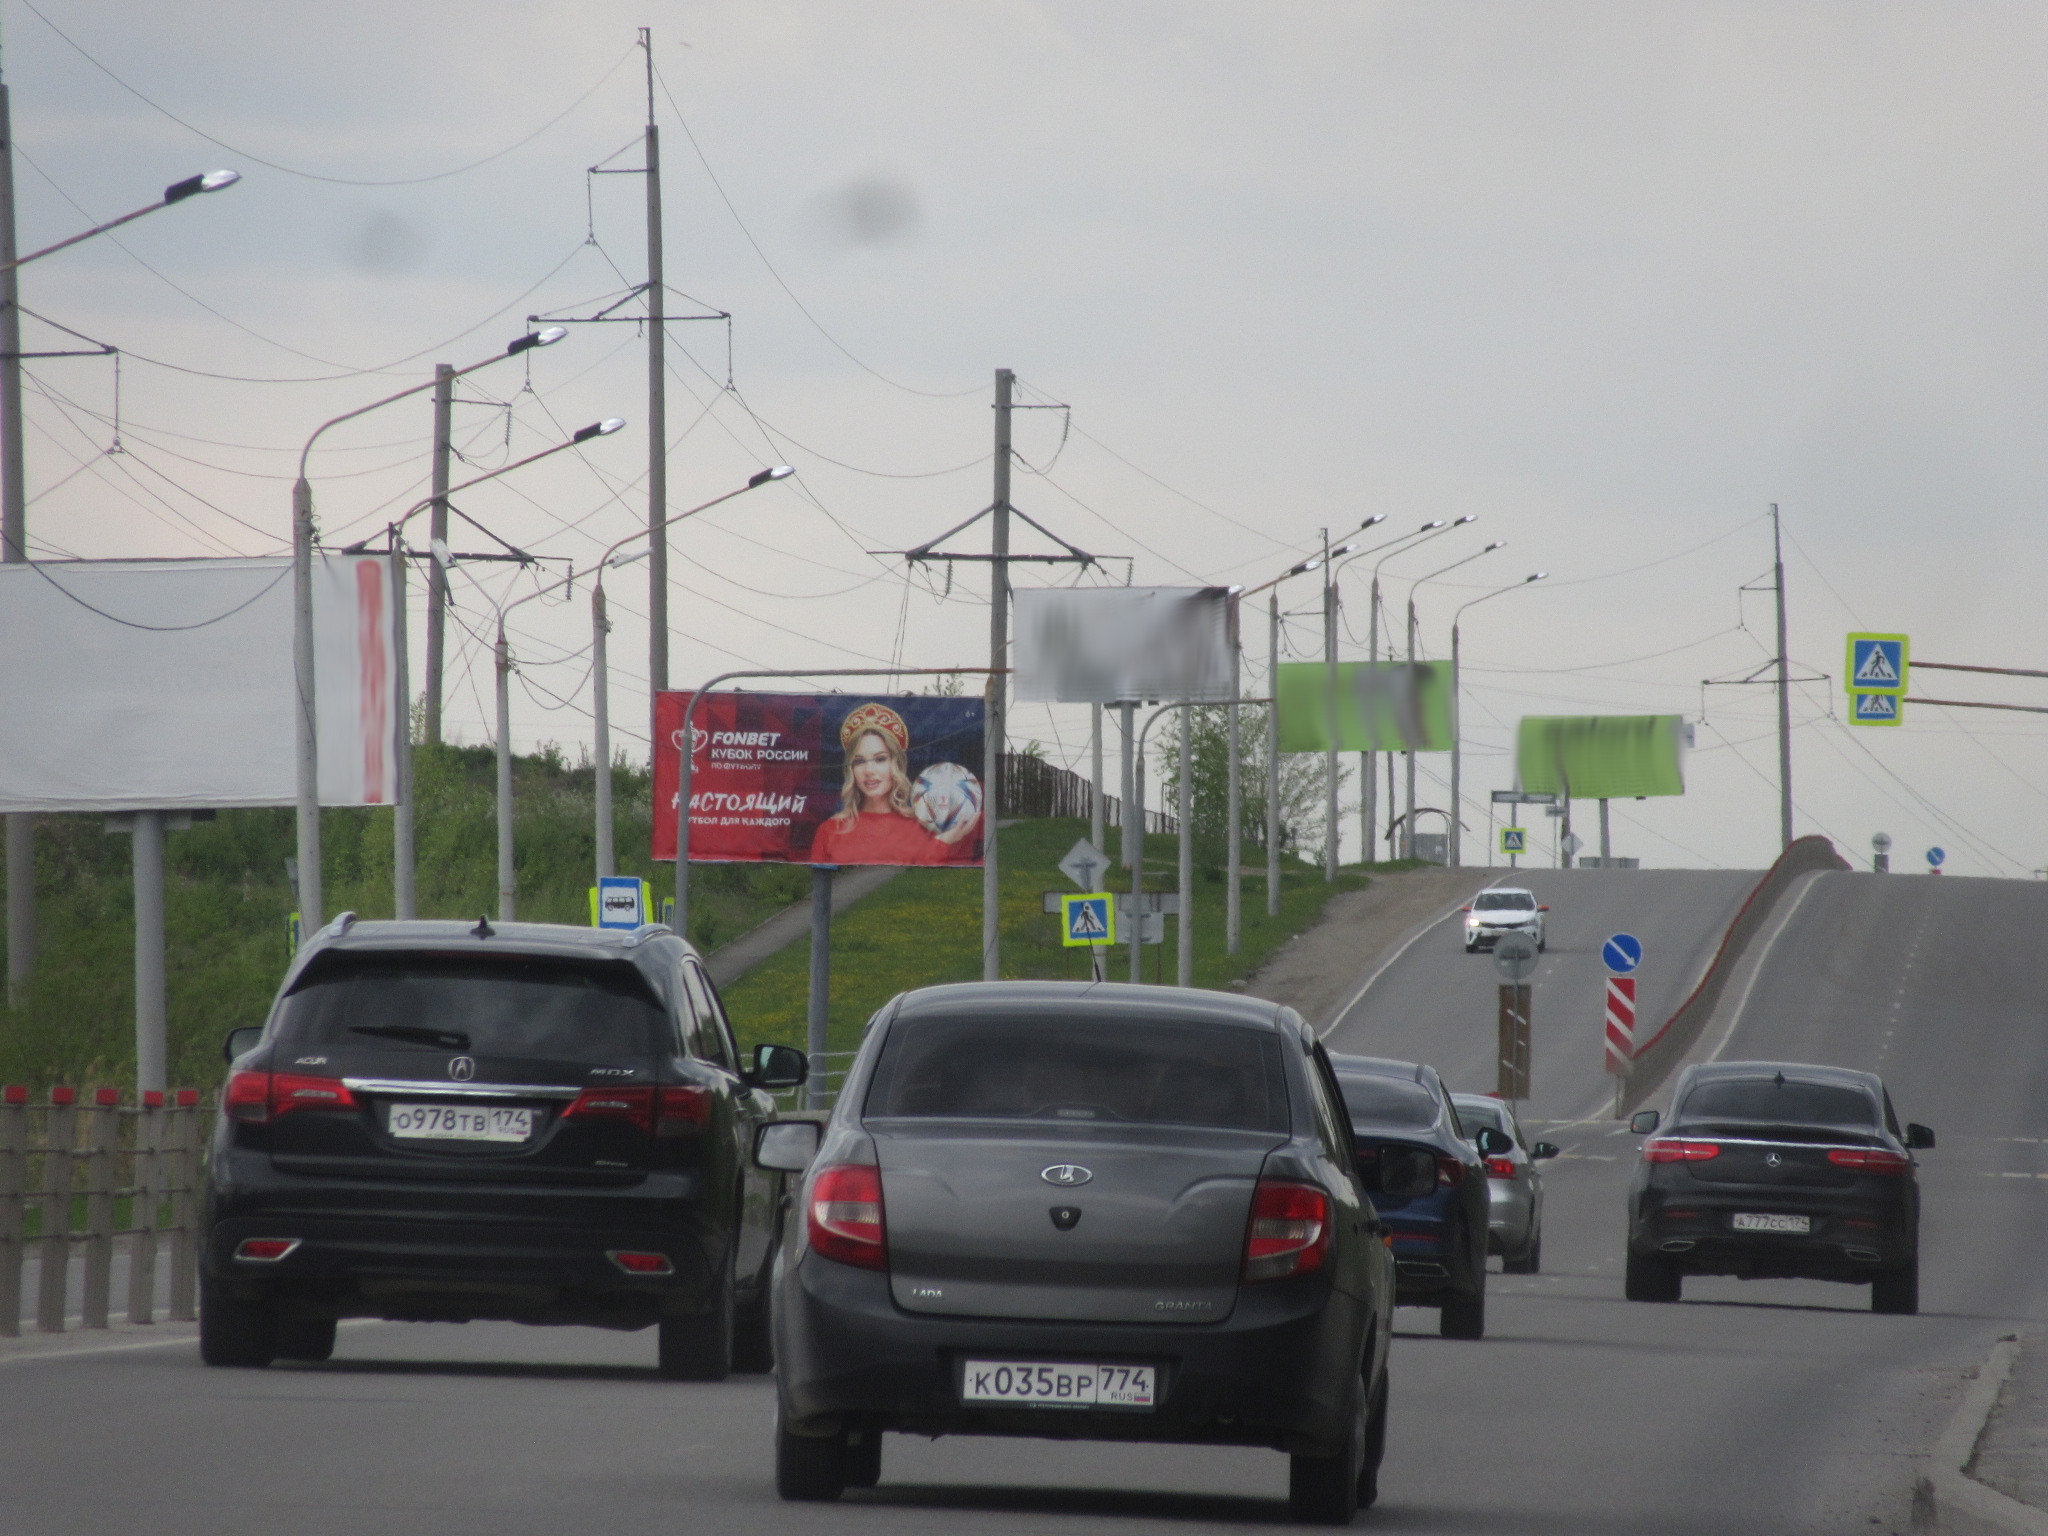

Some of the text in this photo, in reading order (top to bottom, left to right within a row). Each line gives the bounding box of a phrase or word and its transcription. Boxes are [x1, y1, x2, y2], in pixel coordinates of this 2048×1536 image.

[712, 731, 781, 747] FONBET
[711, 749, 809, 761] КУБОК РОССИИ
[720, 817, 740, 826] ДЛЯ
[742, 817, 791, 827] КАЖДОГО
[590, 1068, 635, 1076] MDX
[492, 1110, 529, 1127] 174
[1154, 1301, 1212, 1310] GRANTA
[974, 1366, 1147, 1398] К035ВР 774
[1110, 1392, 1133, 1401] RUS
